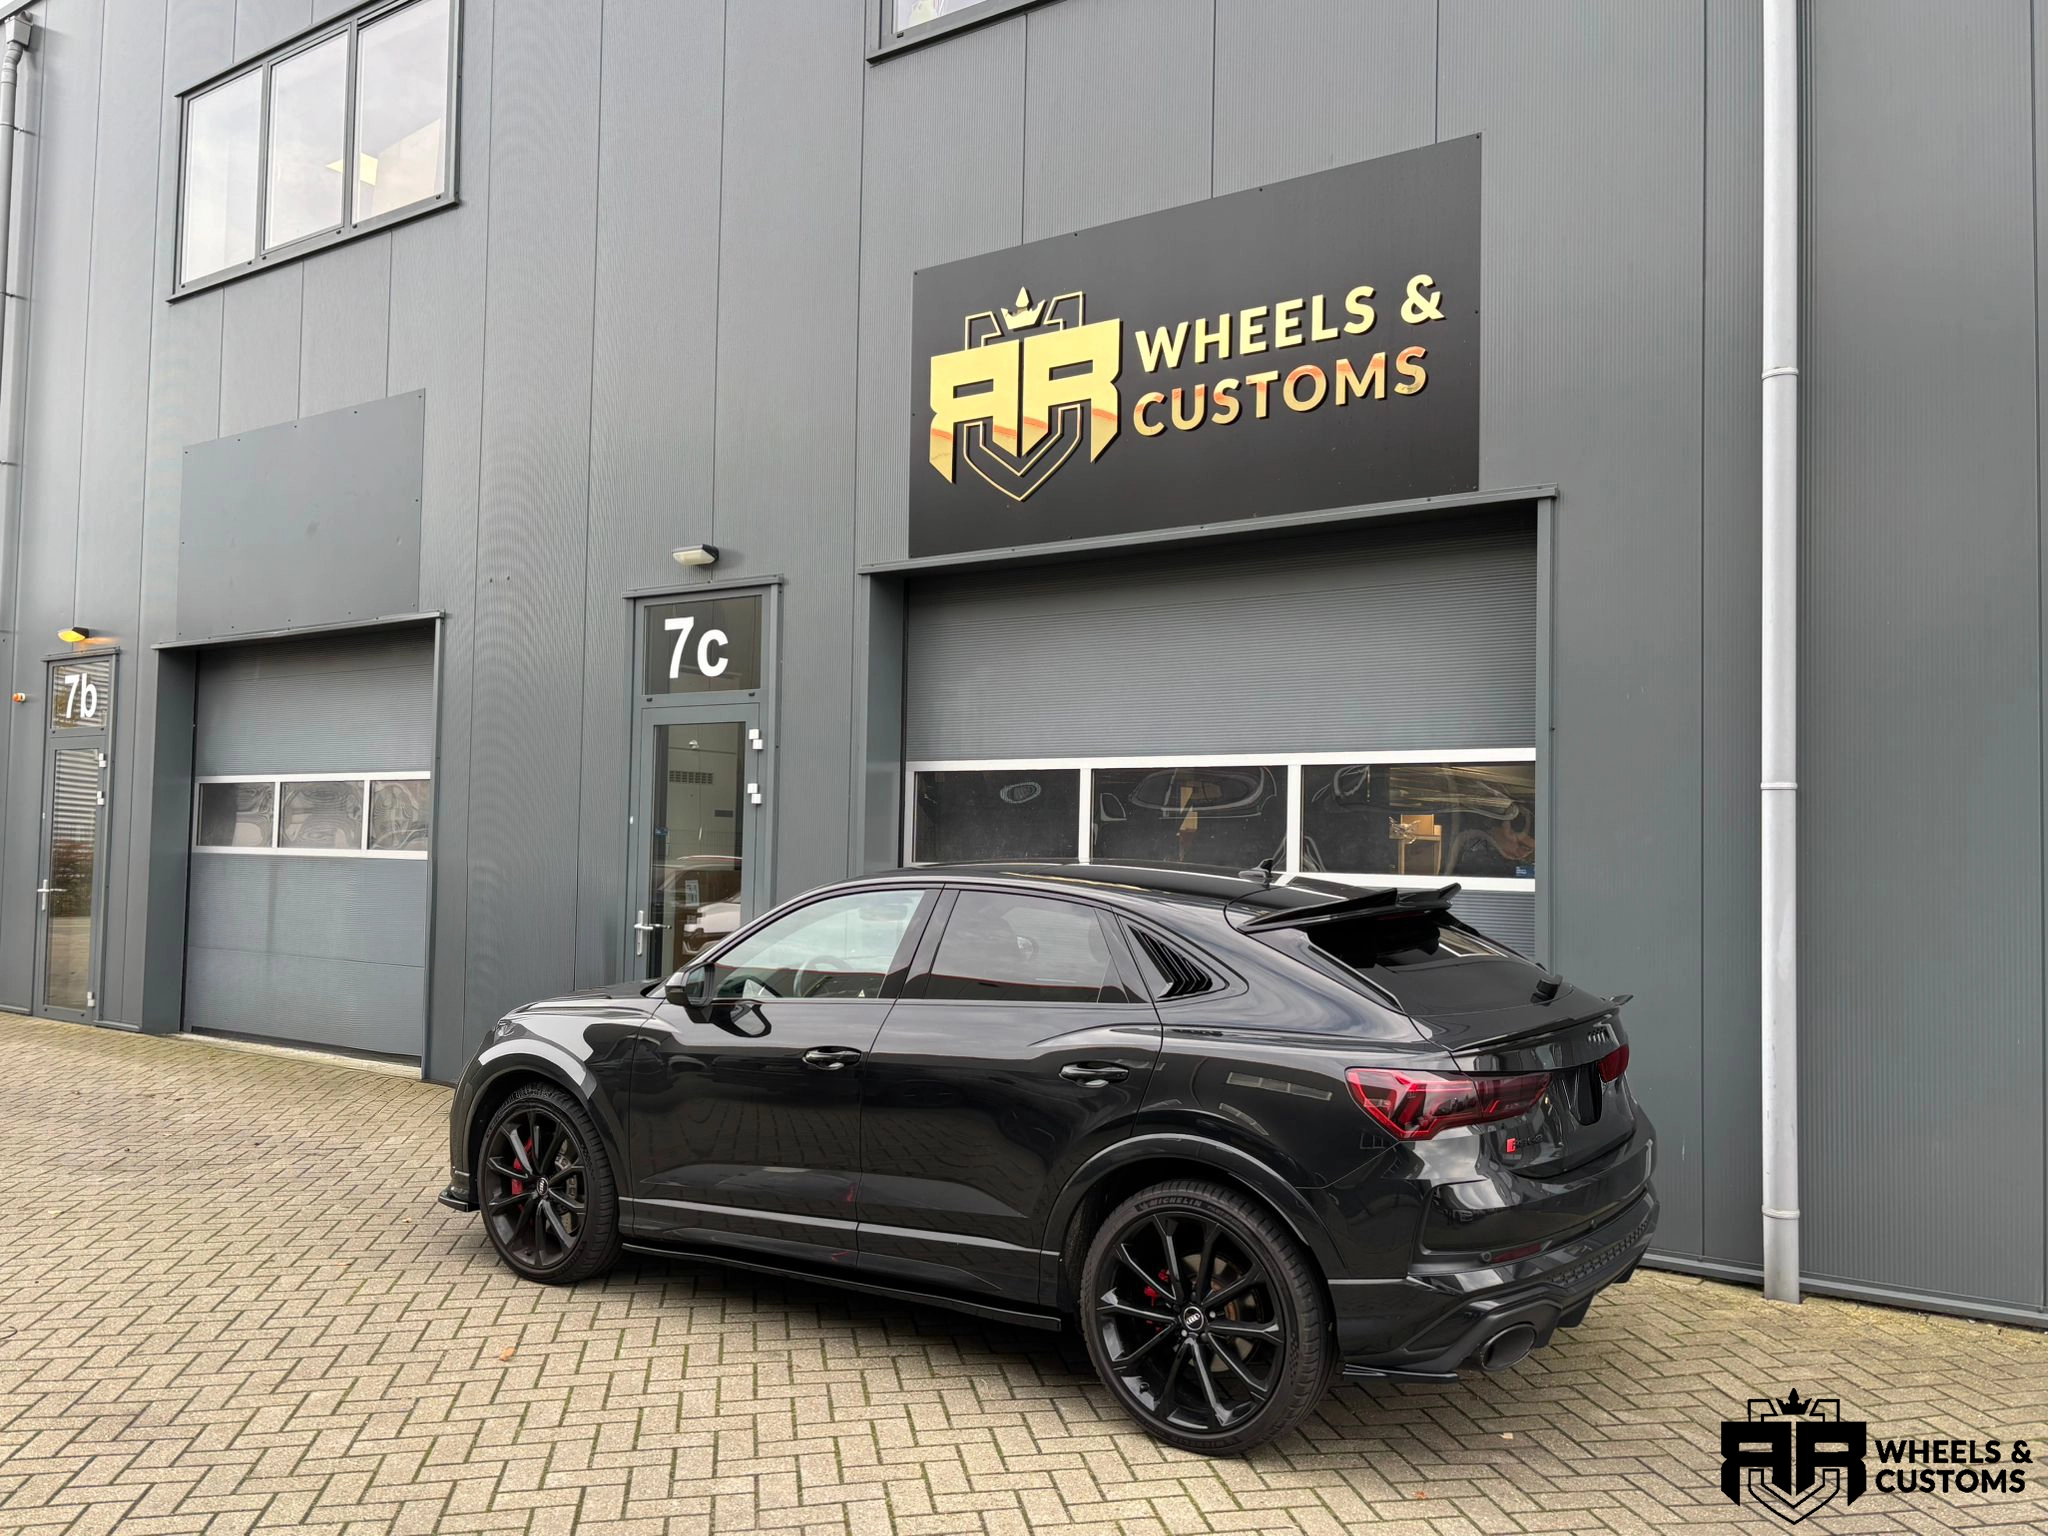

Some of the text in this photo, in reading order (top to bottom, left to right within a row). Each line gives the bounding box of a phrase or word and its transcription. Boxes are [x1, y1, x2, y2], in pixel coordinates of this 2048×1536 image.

[1134, 274, 1446, 373] WHEELS &
[1132, 346, 1429, 438] CUSTOMS
[664, 616, 729, 679] 7c
[65, 672, 98, 719] 7b
[1149, 1196, 1202, 1207] MICHELIN
